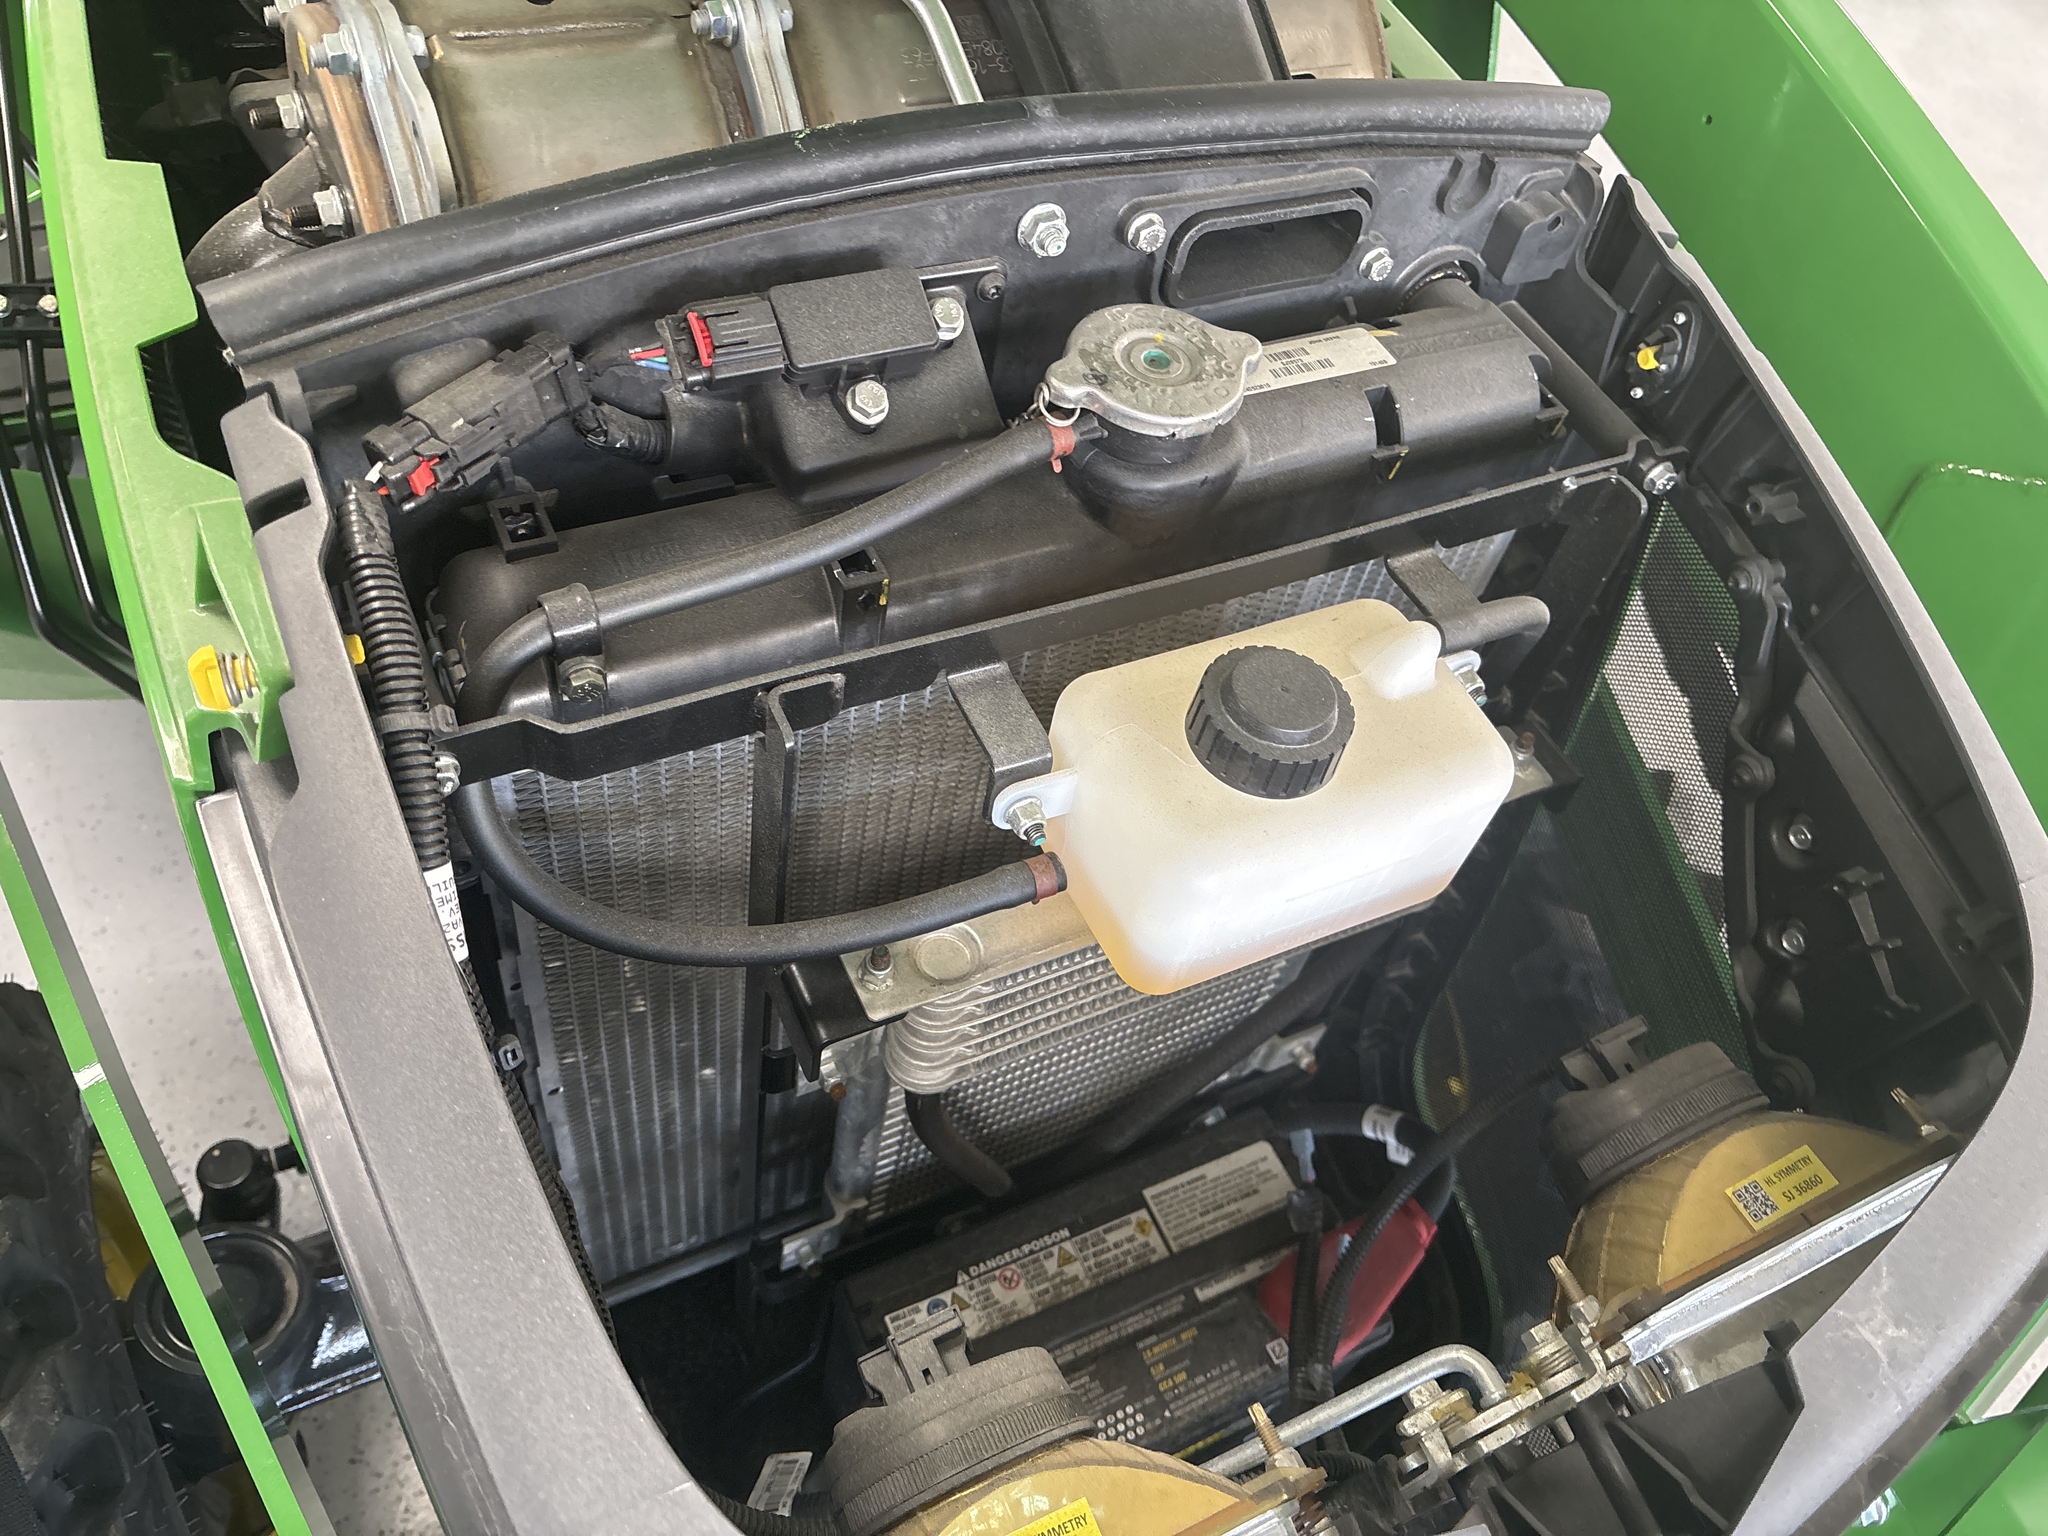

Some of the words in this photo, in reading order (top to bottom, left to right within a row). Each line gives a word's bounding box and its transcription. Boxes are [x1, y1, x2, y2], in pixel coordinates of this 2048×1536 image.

[1763, 1176, 1777, 1188] HL
[1773, 1155, 1813, 1182] SYMMETRY
[1782, 1189, 1796, 1203] SJ
[1793, 1174, 1824, 1197] 36860
[1034, 1513, 1088, 1536] MMETRY
